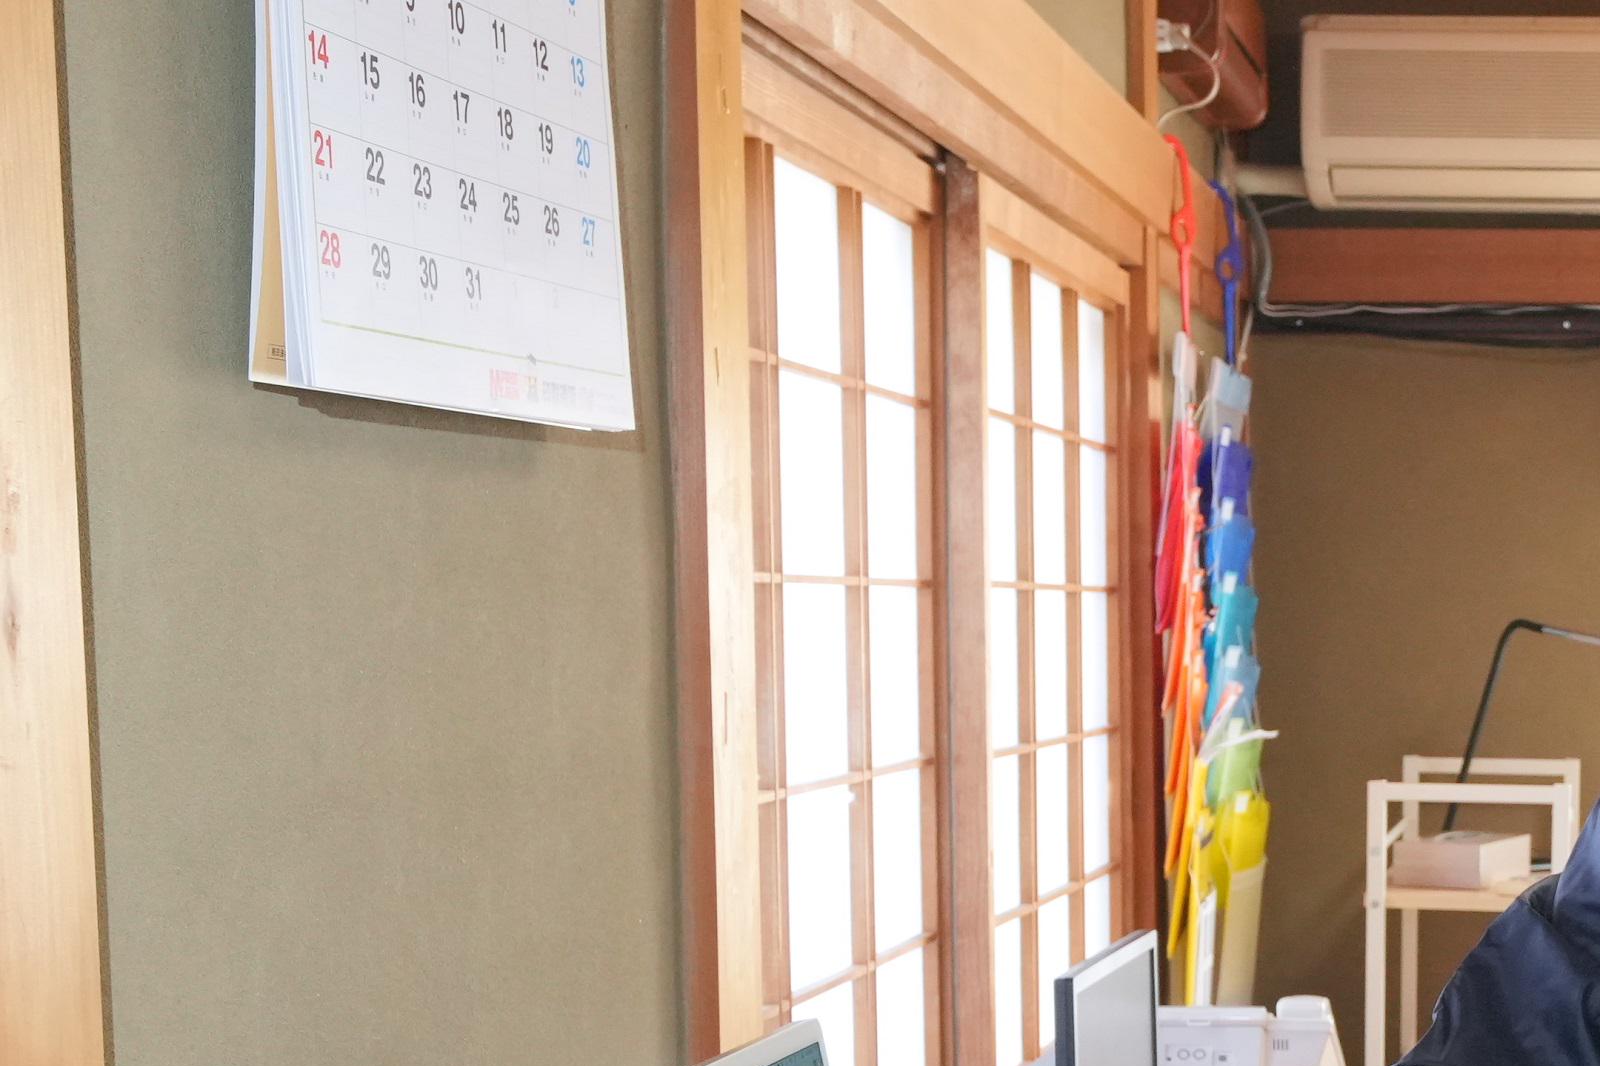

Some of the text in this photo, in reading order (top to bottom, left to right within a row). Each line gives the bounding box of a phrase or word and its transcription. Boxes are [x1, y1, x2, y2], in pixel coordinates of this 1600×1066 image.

[447, 0, 585, 88] 10 11 12 13
[307, 29, 591, 169] 14 15 16 17 18 19 20
[313, 129, 596, 247] 21 22 23 24 25 26 27
[319, 229, 342, 269] 28
[370, 242, 391, 281] 29
[418, 255, 439, 291] 30
[464, 266, 482, 301] 31
